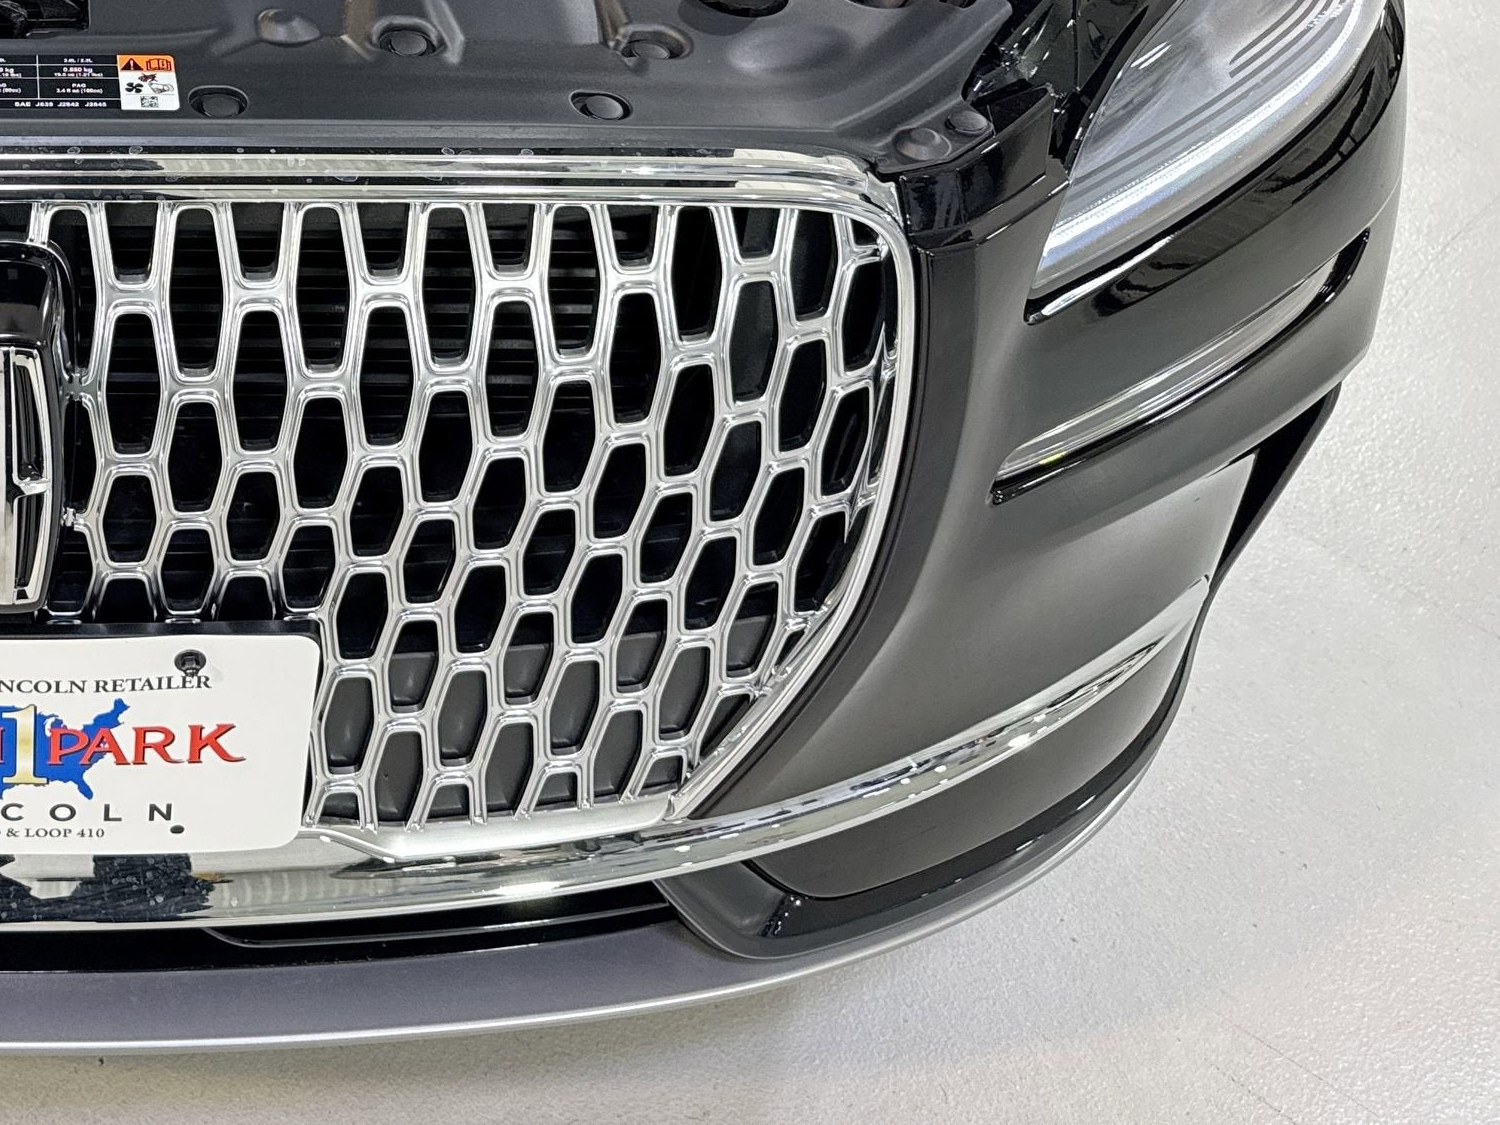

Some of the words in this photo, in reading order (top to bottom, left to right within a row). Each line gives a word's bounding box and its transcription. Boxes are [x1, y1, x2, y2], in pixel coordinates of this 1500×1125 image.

[93, 674, 213, 693] RETAILER
[46, 723, 248, 766] PARK
[6, 827, 20, 838] &
[24, 827, 73, 838] LOOP
[76, 827, 106, 840] 410
